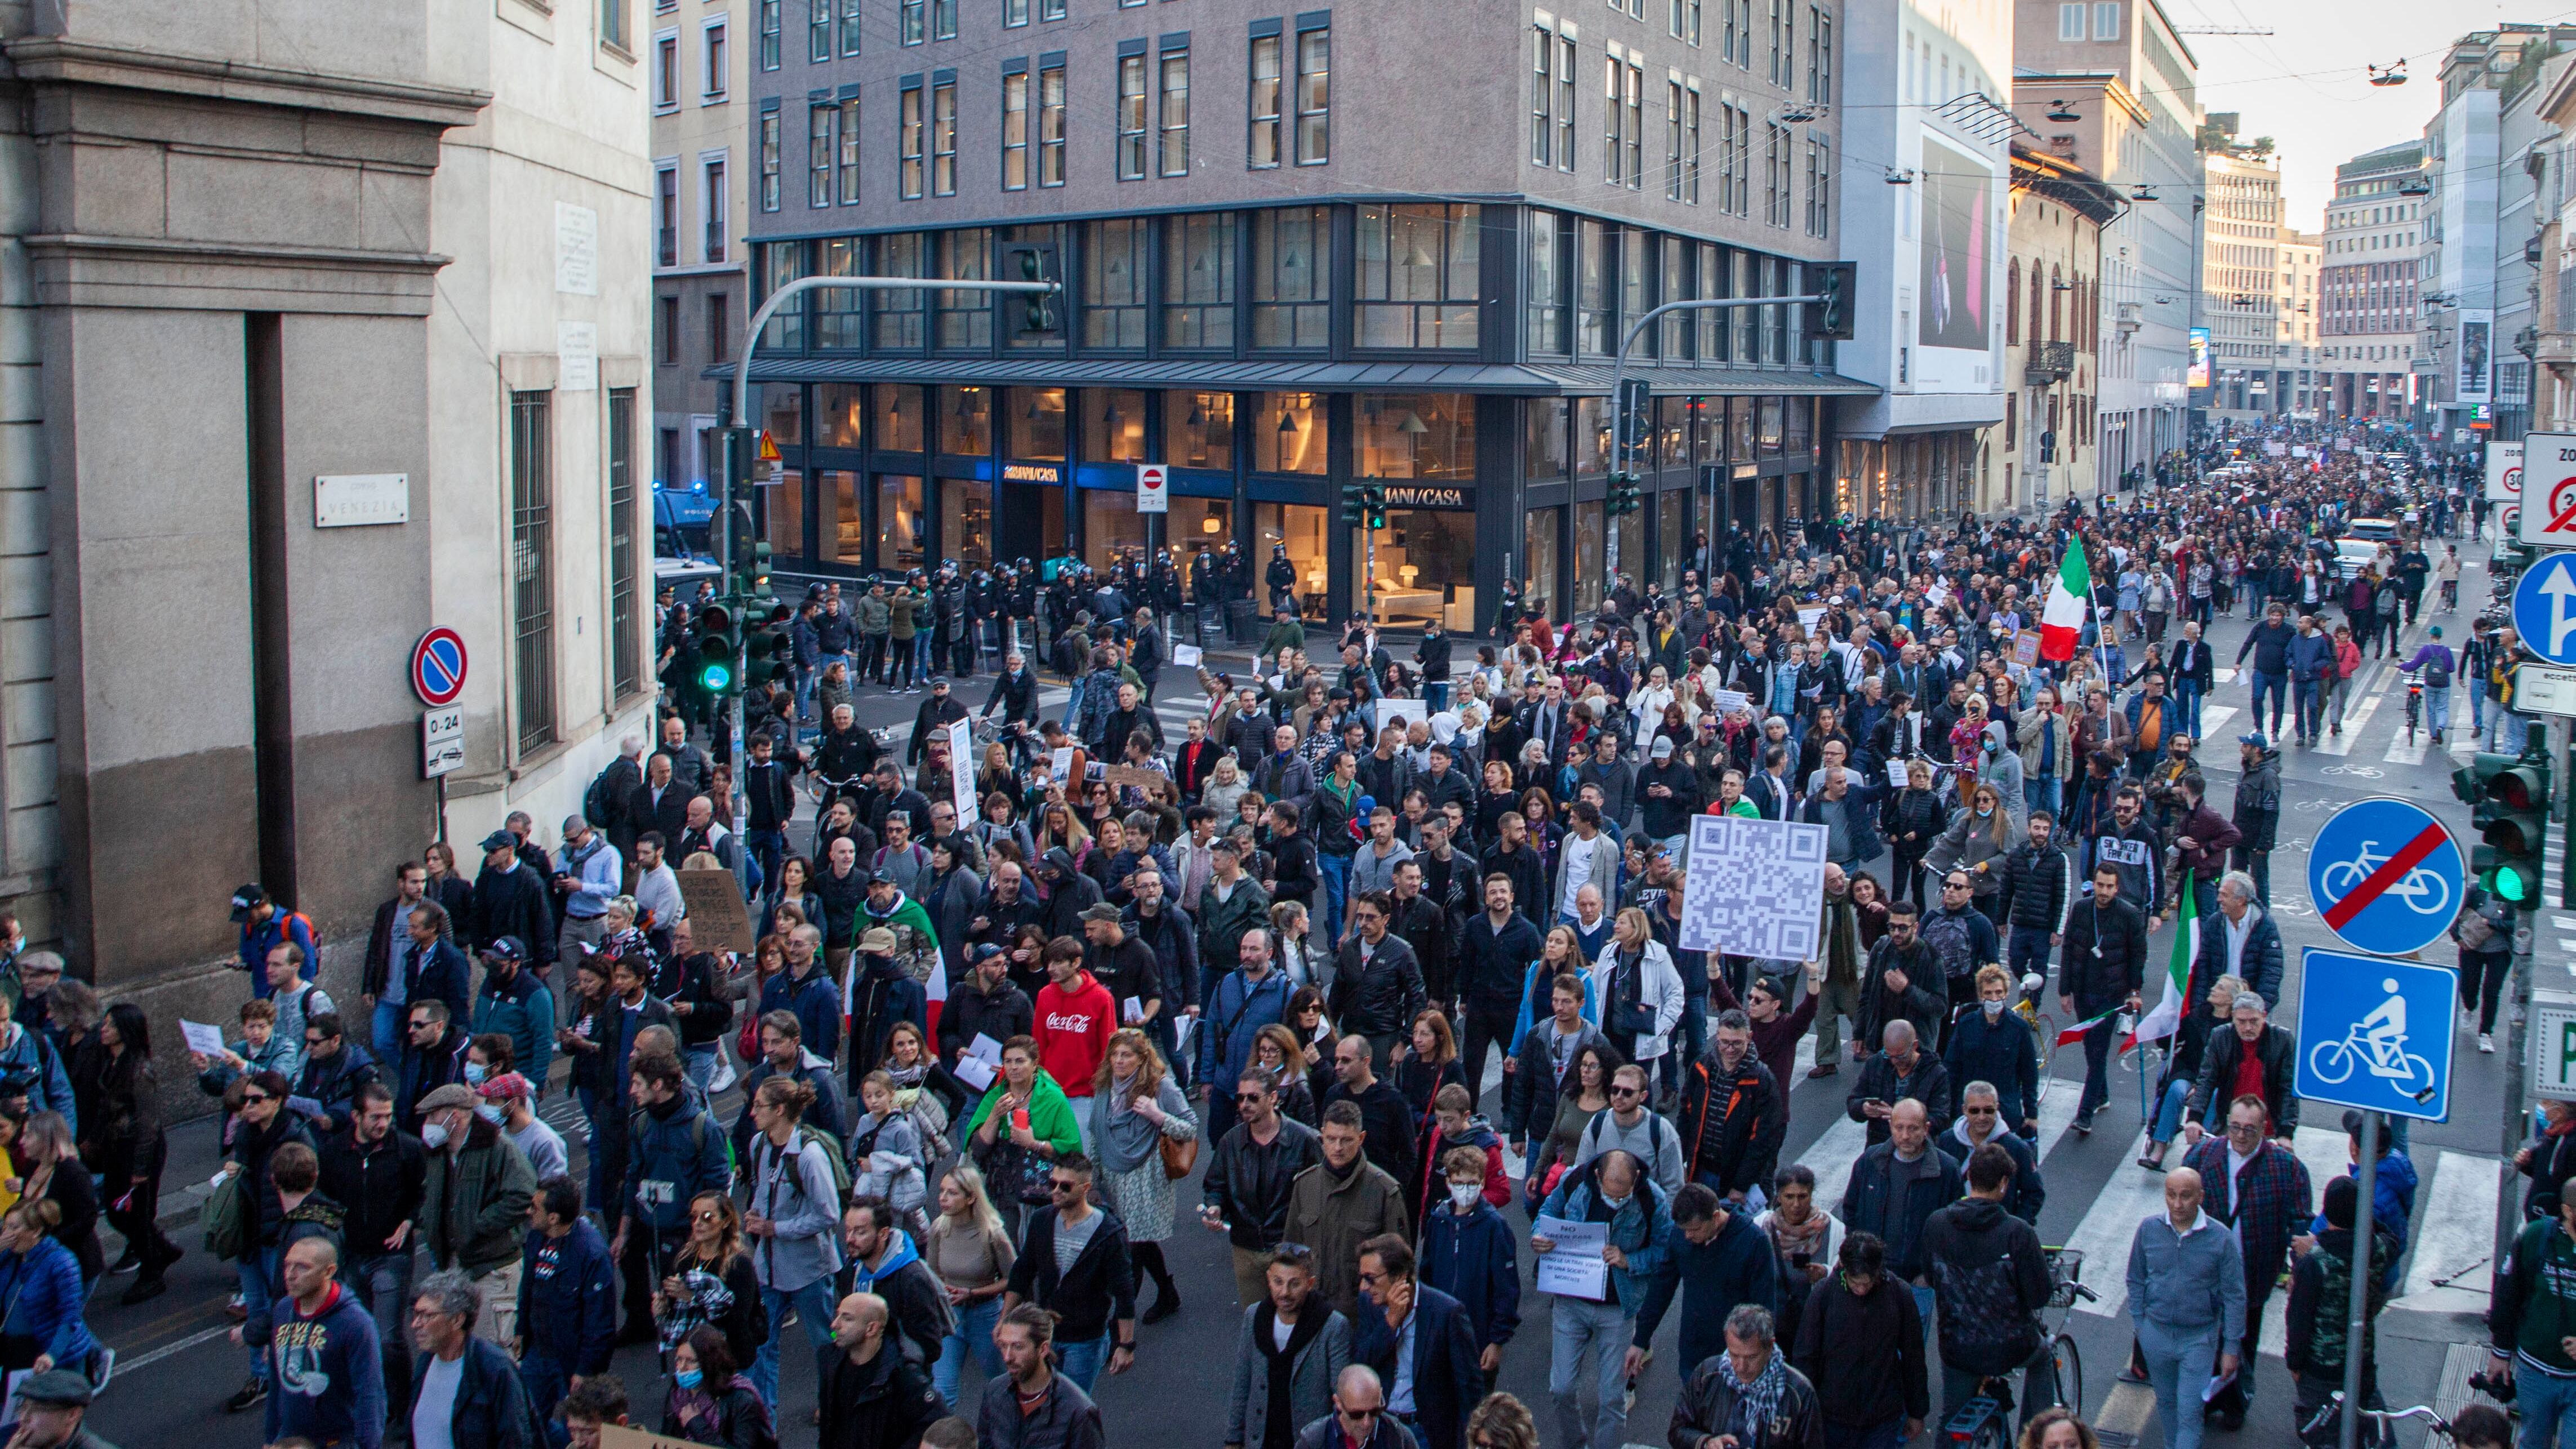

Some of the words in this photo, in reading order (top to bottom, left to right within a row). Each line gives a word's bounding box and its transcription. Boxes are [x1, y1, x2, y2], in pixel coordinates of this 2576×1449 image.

[2559, 448, 2576, 461] zo
[329, 500, 397, 514] VENEZIA
[430, 714, 459, 734] 0-24
[1770, 1415, 1791, 1435] 57
